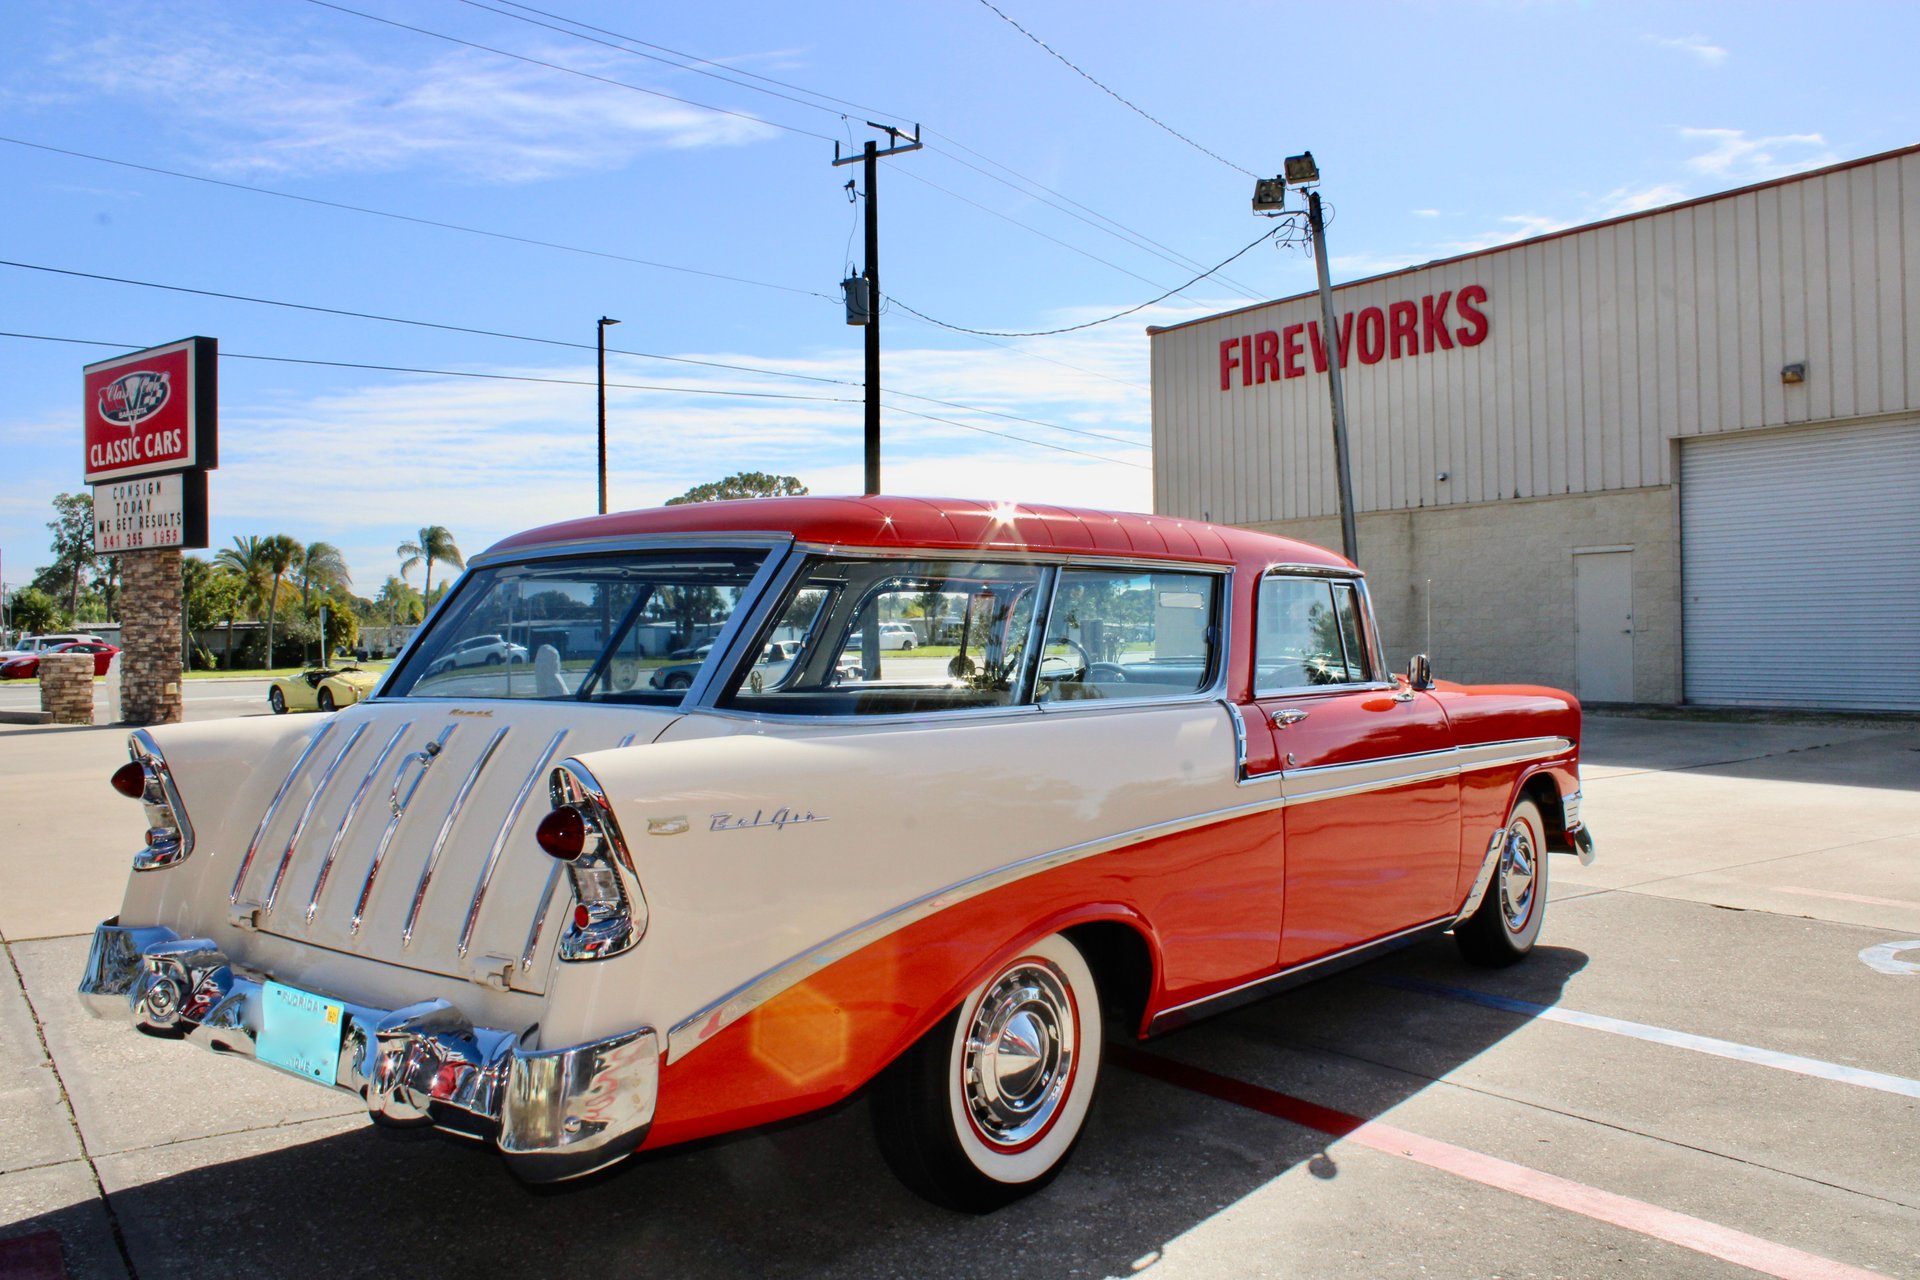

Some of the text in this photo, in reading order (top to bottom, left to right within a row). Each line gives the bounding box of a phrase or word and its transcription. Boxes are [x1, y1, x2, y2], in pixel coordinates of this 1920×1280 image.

[1219, 285, 1488, 391] FIREWORKS
[91, 428, 182, 467] CLASSIC CARS
[113, 481, 162, 500] CONSIGN
[116, 499, 151, 516] TODAY
[99, 512, 182, 534] WE GET RESULTS
[103, 529, 178, 549] 941 355 1955
[282, 991, 320, 1013] FLORIDA
